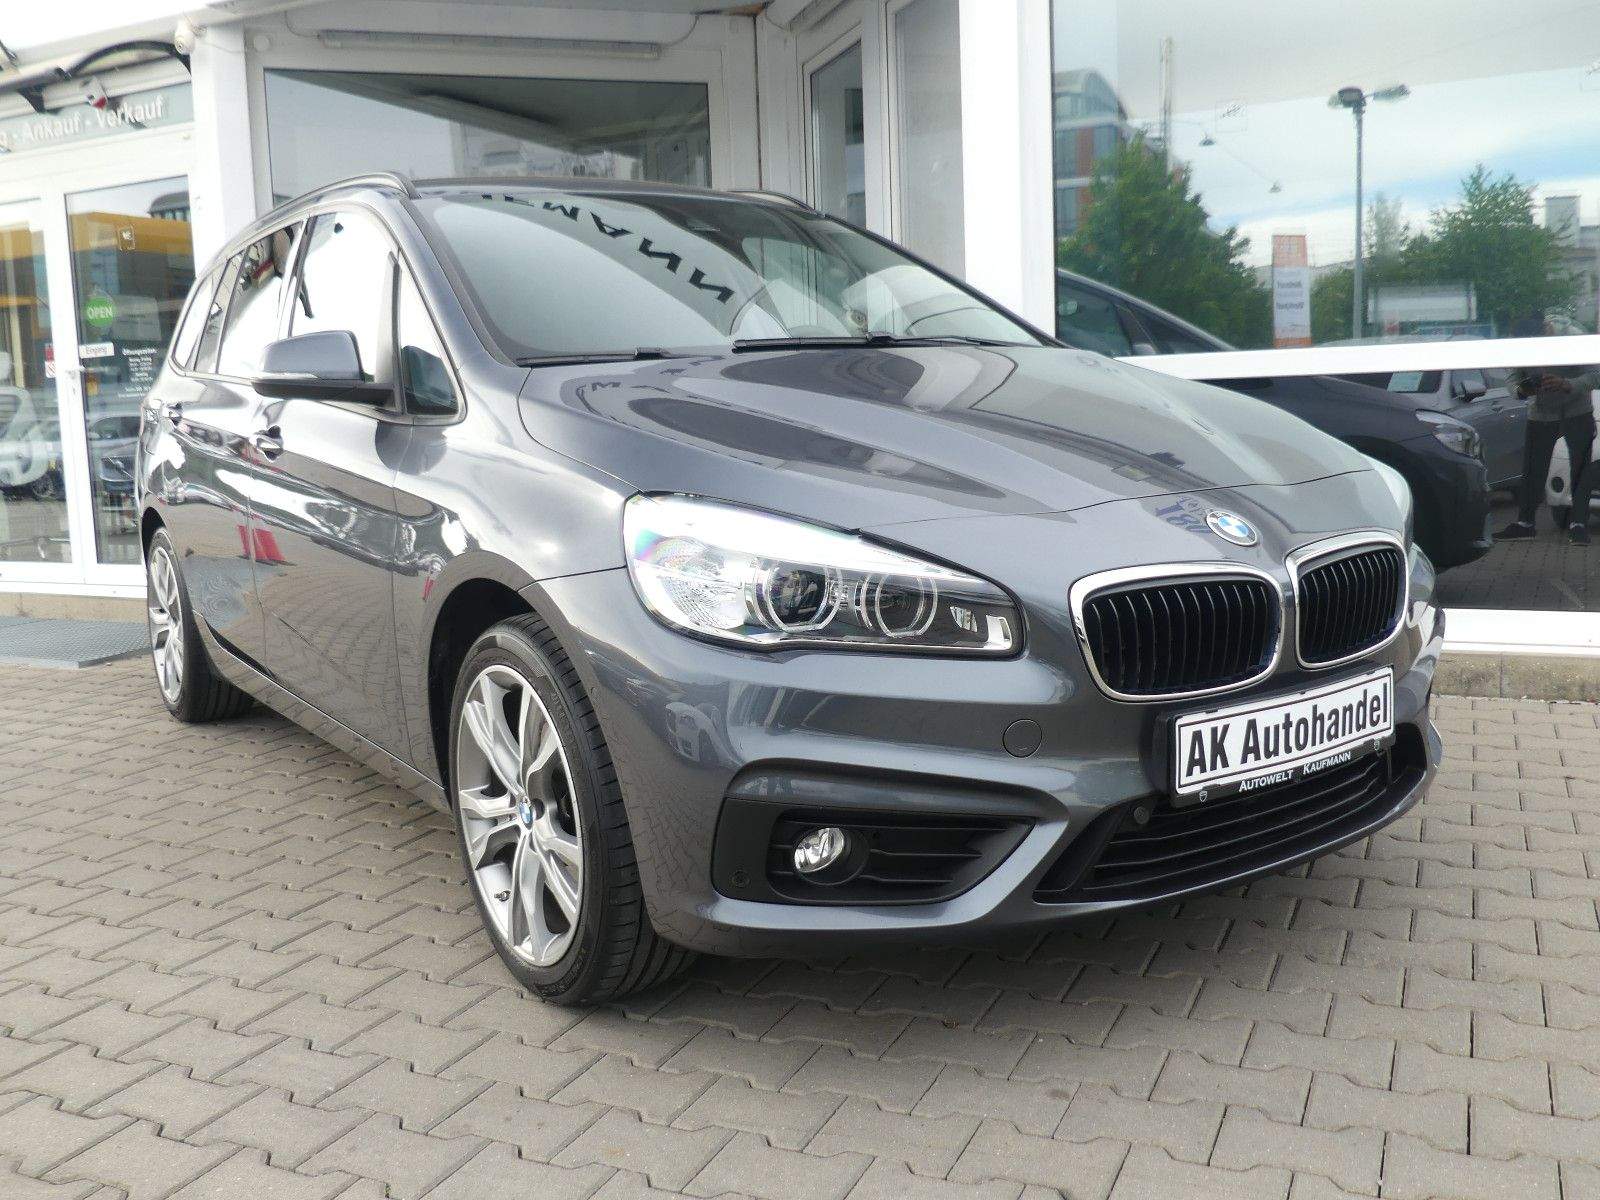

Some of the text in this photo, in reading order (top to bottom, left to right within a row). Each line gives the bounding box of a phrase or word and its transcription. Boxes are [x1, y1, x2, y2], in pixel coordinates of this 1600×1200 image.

[23, 112, 81, 142] Ankauf
[96, 95, 165, 129] Verkauf
[87, 304, 113, 320] OPEN
[1185, 682, 1388, 778] AK Autohandel
[1238, 750, 1352, 793] AUTOWELT KAUFMANN
